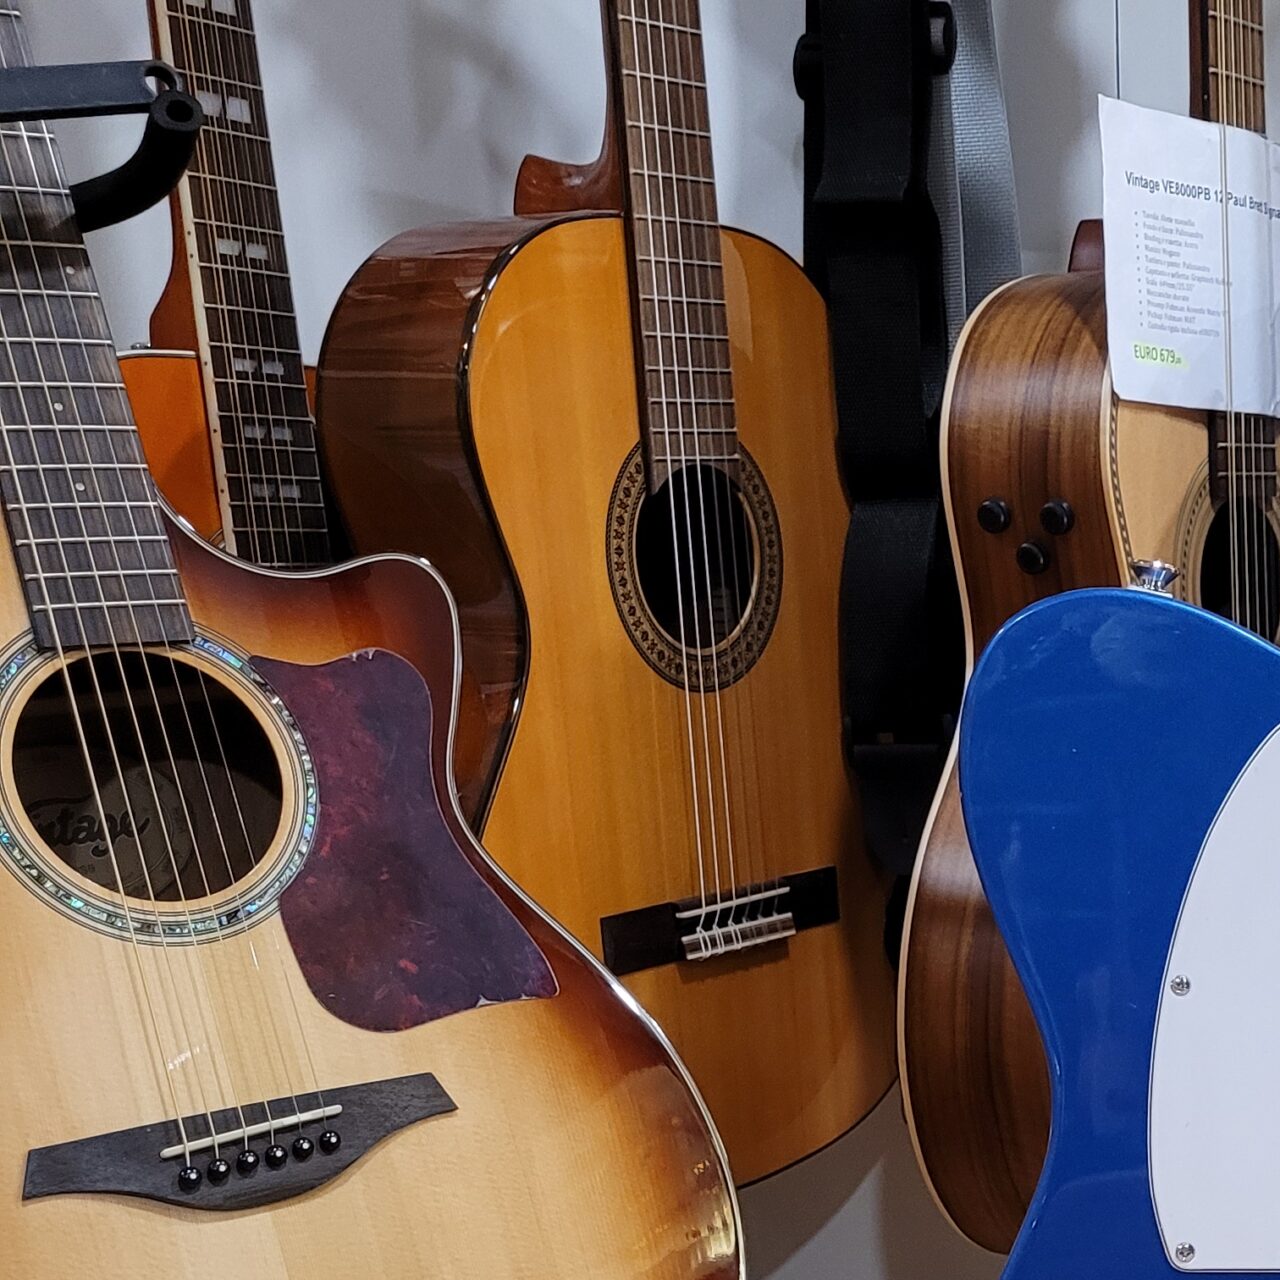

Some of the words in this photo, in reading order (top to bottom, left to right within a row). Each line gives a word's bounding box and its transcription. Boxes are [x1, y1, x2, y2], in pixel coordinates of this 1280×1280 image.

[1125, 171, 1160, 193] Vintage
[1162, 178, 1211, 201] VE8000PB
[1226, 191, 1247, 208] Paul
[1134, 344, 1158, 361] EURO
